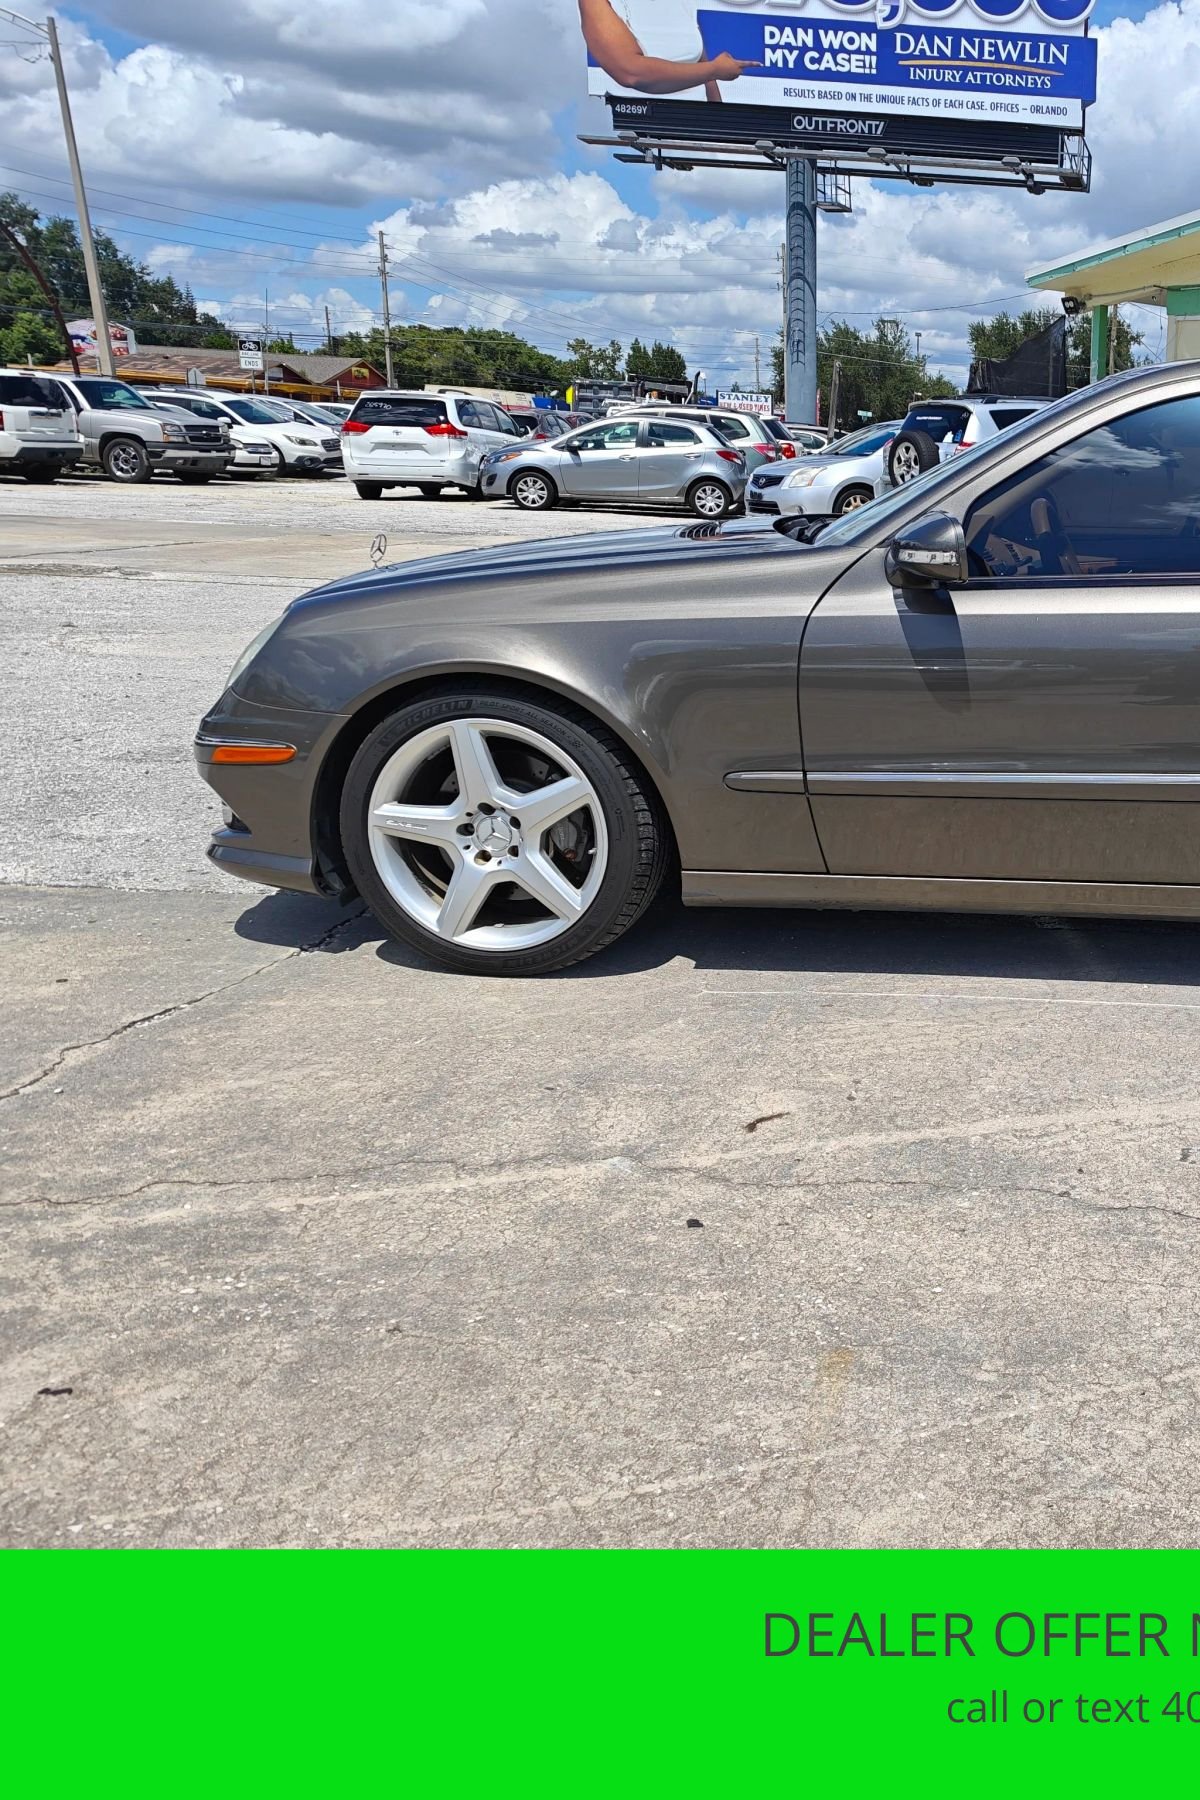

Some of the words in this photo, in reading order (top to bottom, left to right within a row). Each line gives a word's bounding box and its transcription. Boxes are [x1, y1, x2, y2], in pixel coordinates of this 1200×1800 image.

[764, 25, 814, 47] DAN
[818, 29, 877, 52] WON
[894, 32, 953, 57] DAN
[958, 36, 1070, 66] NEWLIN
[764, 48, 799, 69] MY
[803, 50, 877, 75] CASE!!
[909, 67, 963, 83] INJURY
[965, 71, 1051, 89] ATTORNEYS
[615, 104, 648, 115] 48269Y
[783, 87, 816, 99] RESULTS
[817, 90, 843, 101] BASED
[845, 91, 857, 102] ON
[859, 93, 873, 103] THE
[875, 94, 906, 105] UNIQUE
[907, 96, 930, 107] FACTS
[932, 98, 942, 108] OF
[944, 99, 964, 109] EACH
[966, 100, 988, 111] CASE.
[990, 102, 1020, 113] OFFICES
[1030, 104, 1068, 116] ORLANDO
[719, 392, 770, 403] STANLEY
[739, 402, 753, 411] USED
